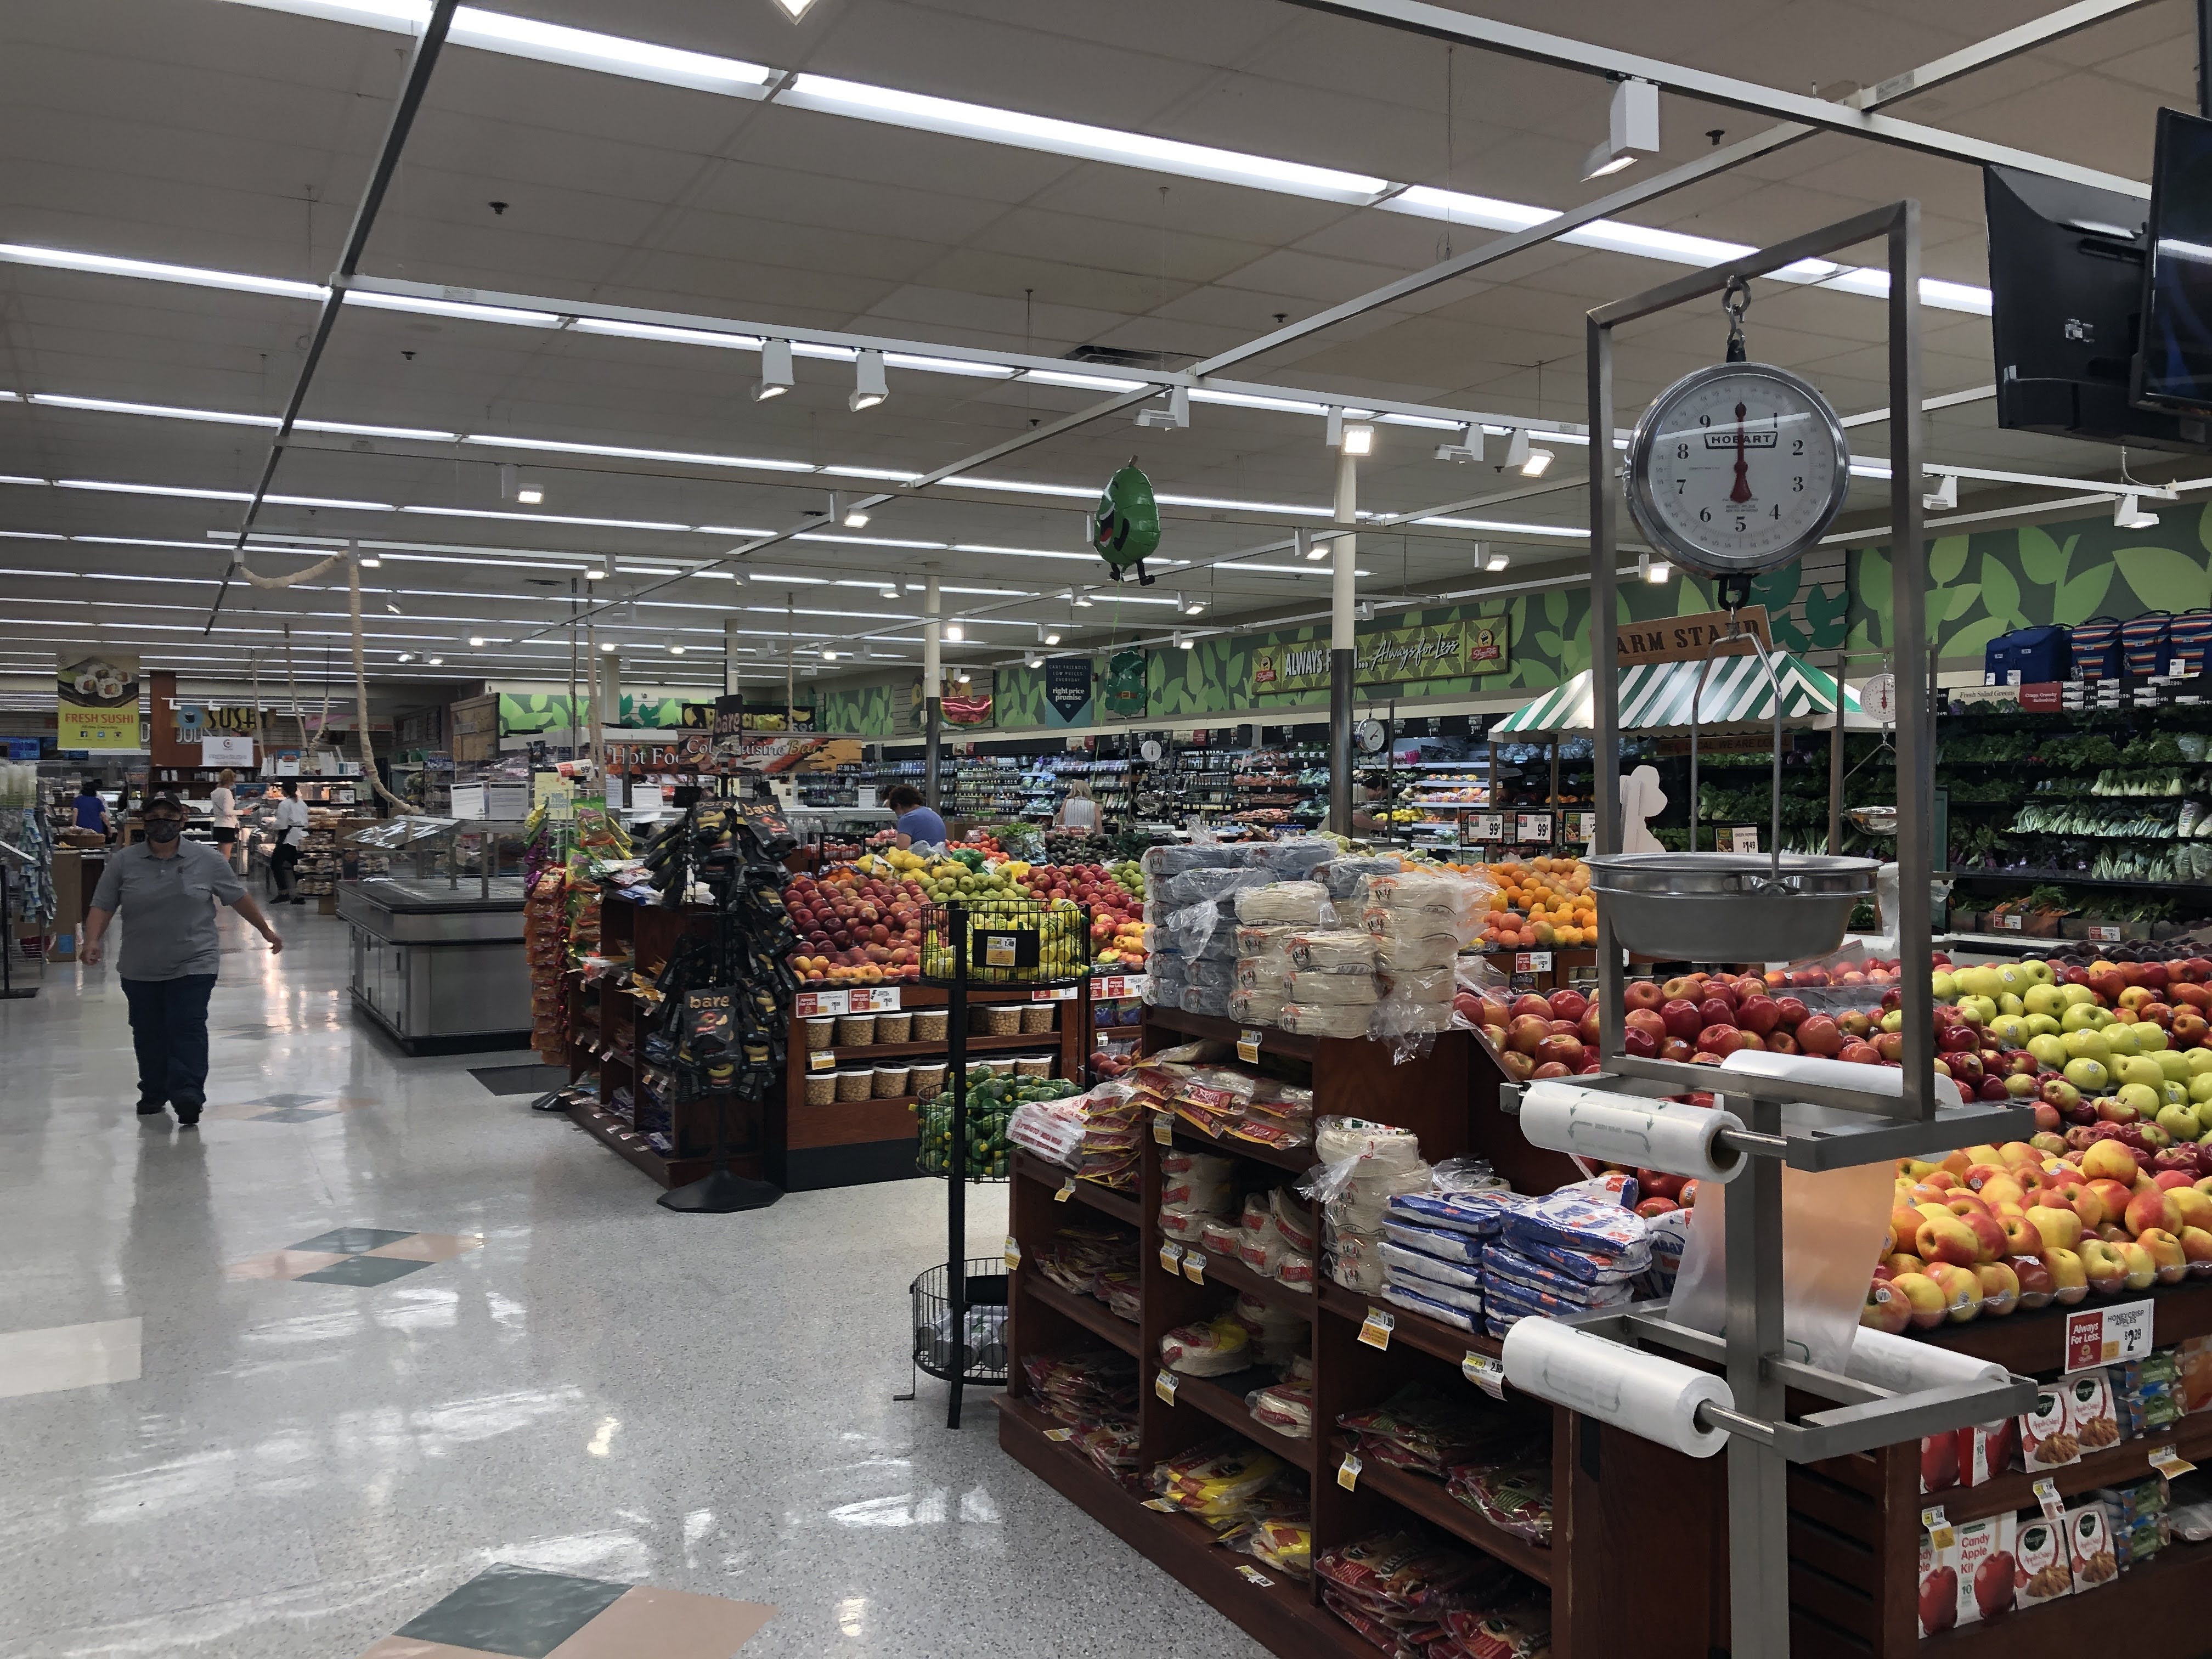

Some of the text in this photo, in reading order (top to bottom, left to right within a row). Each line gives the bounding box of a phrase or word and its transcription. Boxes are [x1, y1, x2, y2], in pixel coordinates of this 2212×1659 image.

[1700, 415, 1711, 427] 9
[1774, 413, 1778, 428] 1
[1712, 435, 1771, 443] HOBART
[1678, 443, 1689, 459] 8
[1793, 440, 1803, 455] 2
[1677, 479, 1686, 494] 7
[1793, 476, 1803, 492] 3
[1700, 506, 1711, 522] 6
[1769, 504, 1781, 520] 4
[1735, 516, 1746, 532] 5
[1617, 631, 1665, 655] ARM
[1371, 640, 1417, 670] Always
[1415, 637, 1435, 667] for
[1434, 632, 1459, 659] Less
[1473, 647, 1497, 660] ShopRite
[1286, 650, 1323, 676] ALWAYS
[1053, 687, 1085, 696] right price
[1056, 694, 1082, 702] promise
[65, 714, 133, 724] FRESH SUSHI
[208, 707, 267, 733] SUSHI
[715, 713, 740, 733] bare
[687, 738, 819, 756] Col uisine Bar
[612, 748, 679, 765] Hot Fo
[742, 803, 777, 816] bare
[1489, 822, 1500, 836] 99¢
[1538, 823, 1548, 837] 99¢
[690, 996, 730, 1008] bare
[2108, 1310, 2144, 1322] HONEYCRISP
[2073, 1323, 2098, 1334] Always
[2071, 1333, 2100, 1345] For Less.
[1976, 1444, 1984, 1455] 10
[1961, 1533, 1990, 1548] Candy
[1920, 1549, 1933, 1560] ndy
[1961, 1547, 1987, 1560] Apple
[1961, 1564, 1974, 1574] Kit
[1961, 1584, 1972, 1595] 10
